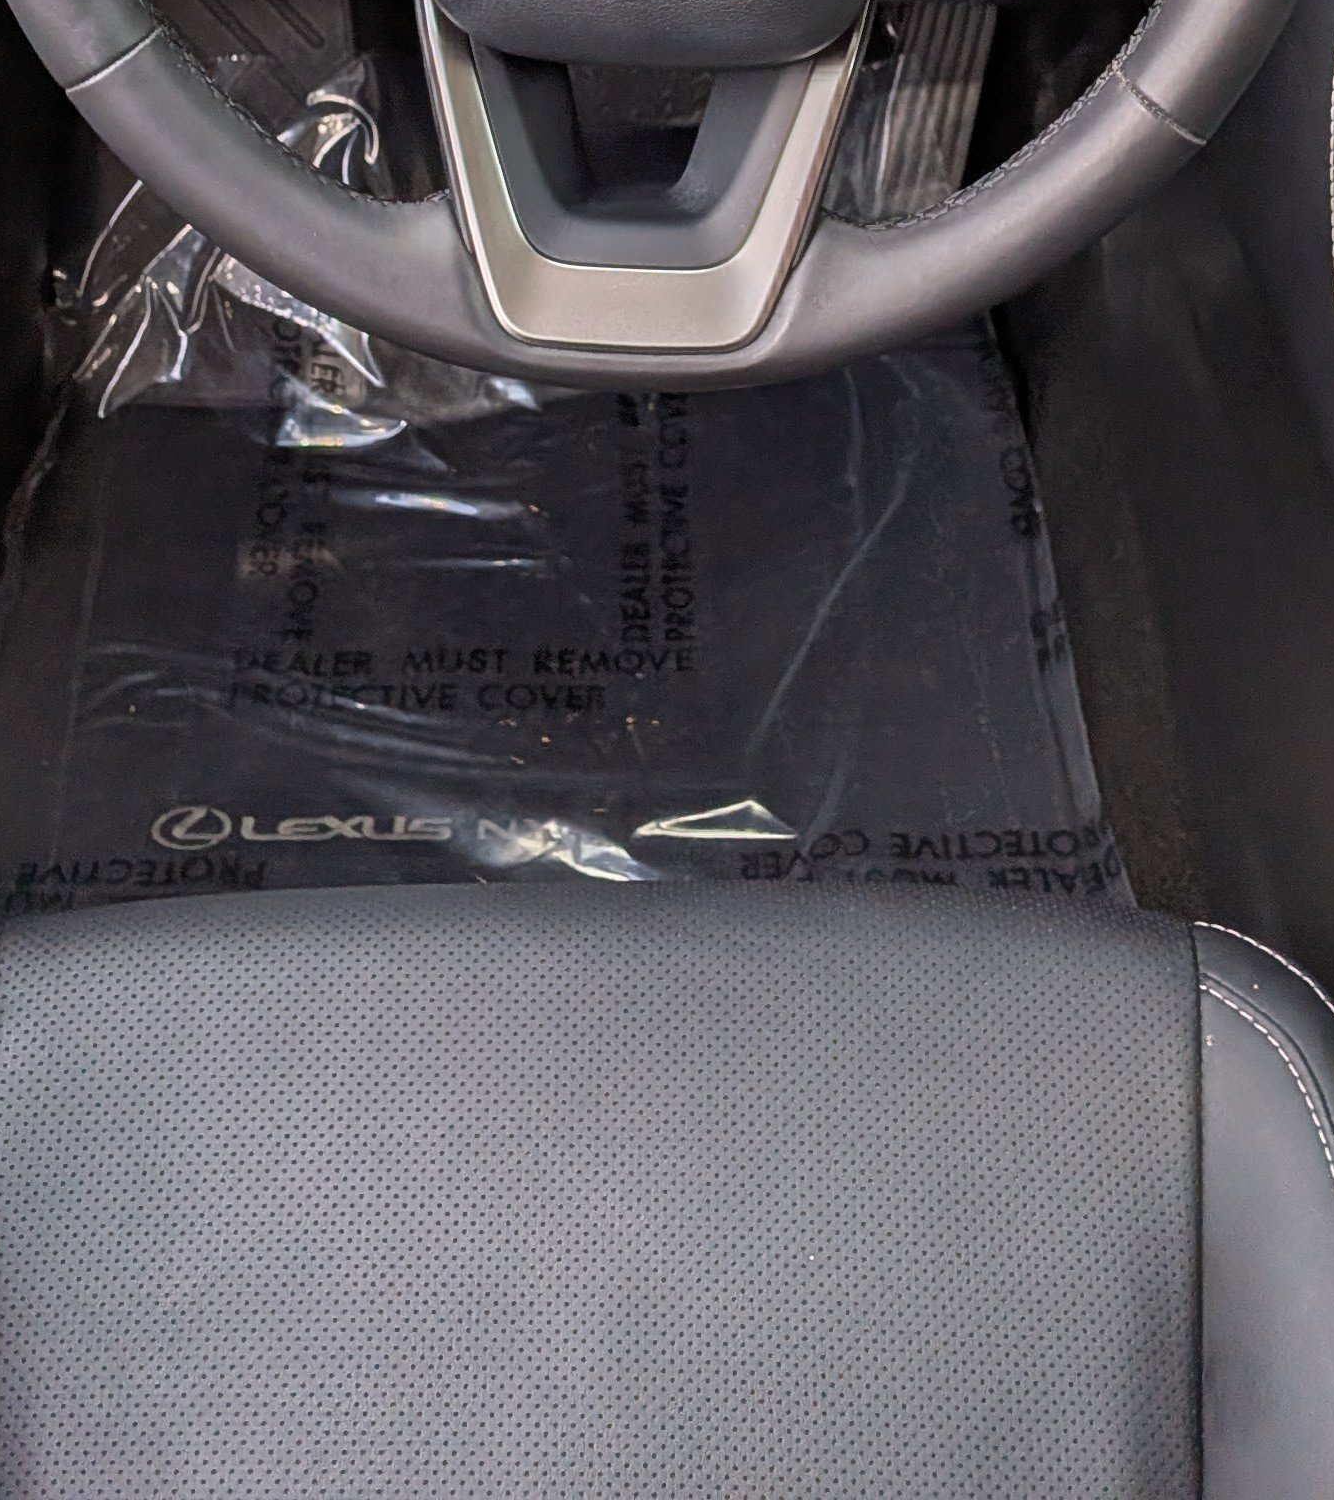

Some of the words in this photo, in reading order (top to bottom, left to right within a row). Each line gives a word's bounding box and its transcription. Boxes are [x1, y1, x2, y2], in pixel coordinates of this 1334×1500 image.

[402, 646, 509, 676] MUST
[534, 644, 696, 678] REMOVE
[477, 682, 608, 712] COVER
[239, 815, 454, 842] LEXUS
